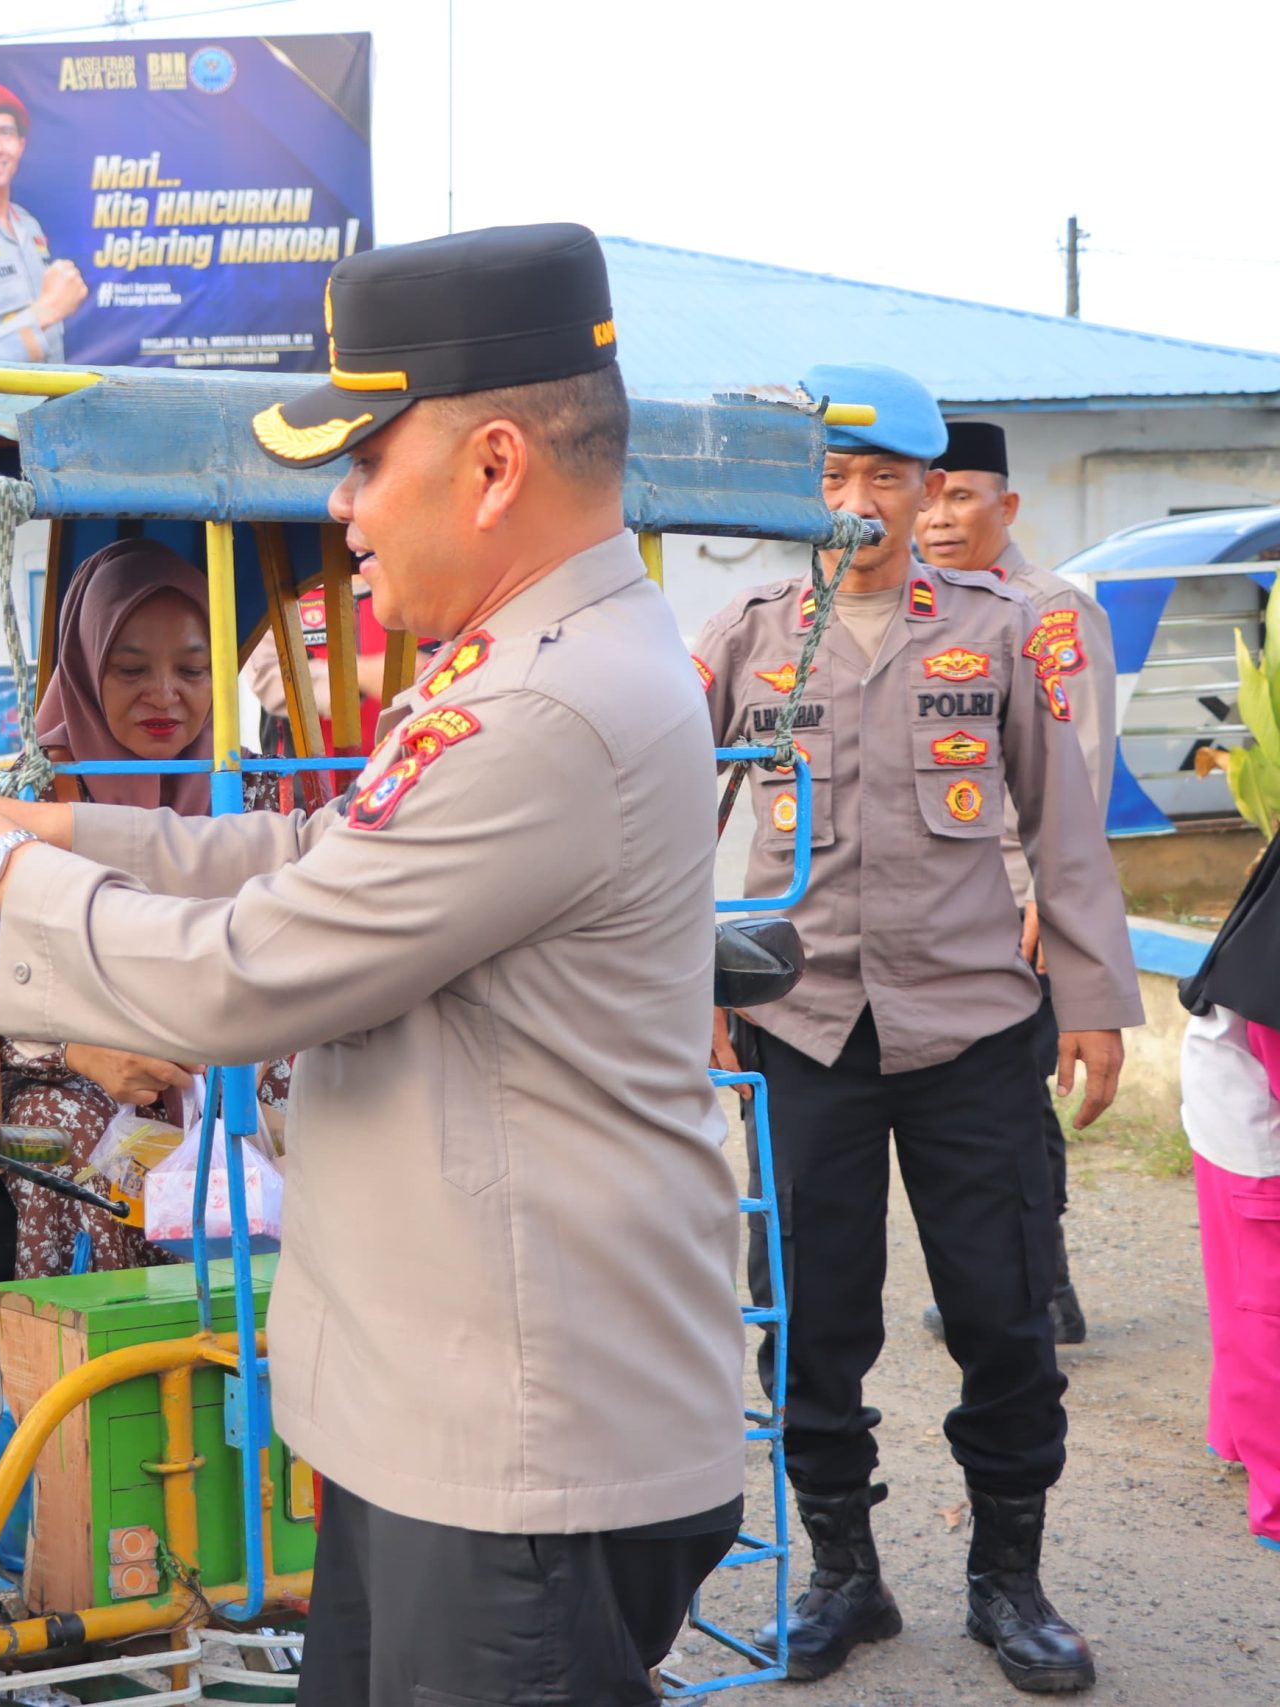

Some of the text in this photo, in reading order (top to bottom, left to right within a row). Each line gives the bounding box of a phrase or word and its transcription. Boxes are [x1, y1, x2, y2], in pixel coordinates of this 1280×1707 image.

[147, 52, 187, 74] BNN
[91, 152, 181, 189] Mari...
[93, 188, 313, 229] Kita HANCURKAN
[94, 229, 215, 271] Jejaring
[218, 227, 340, 264] NARKOBA
[917, 692, 993, 718] POLRI
